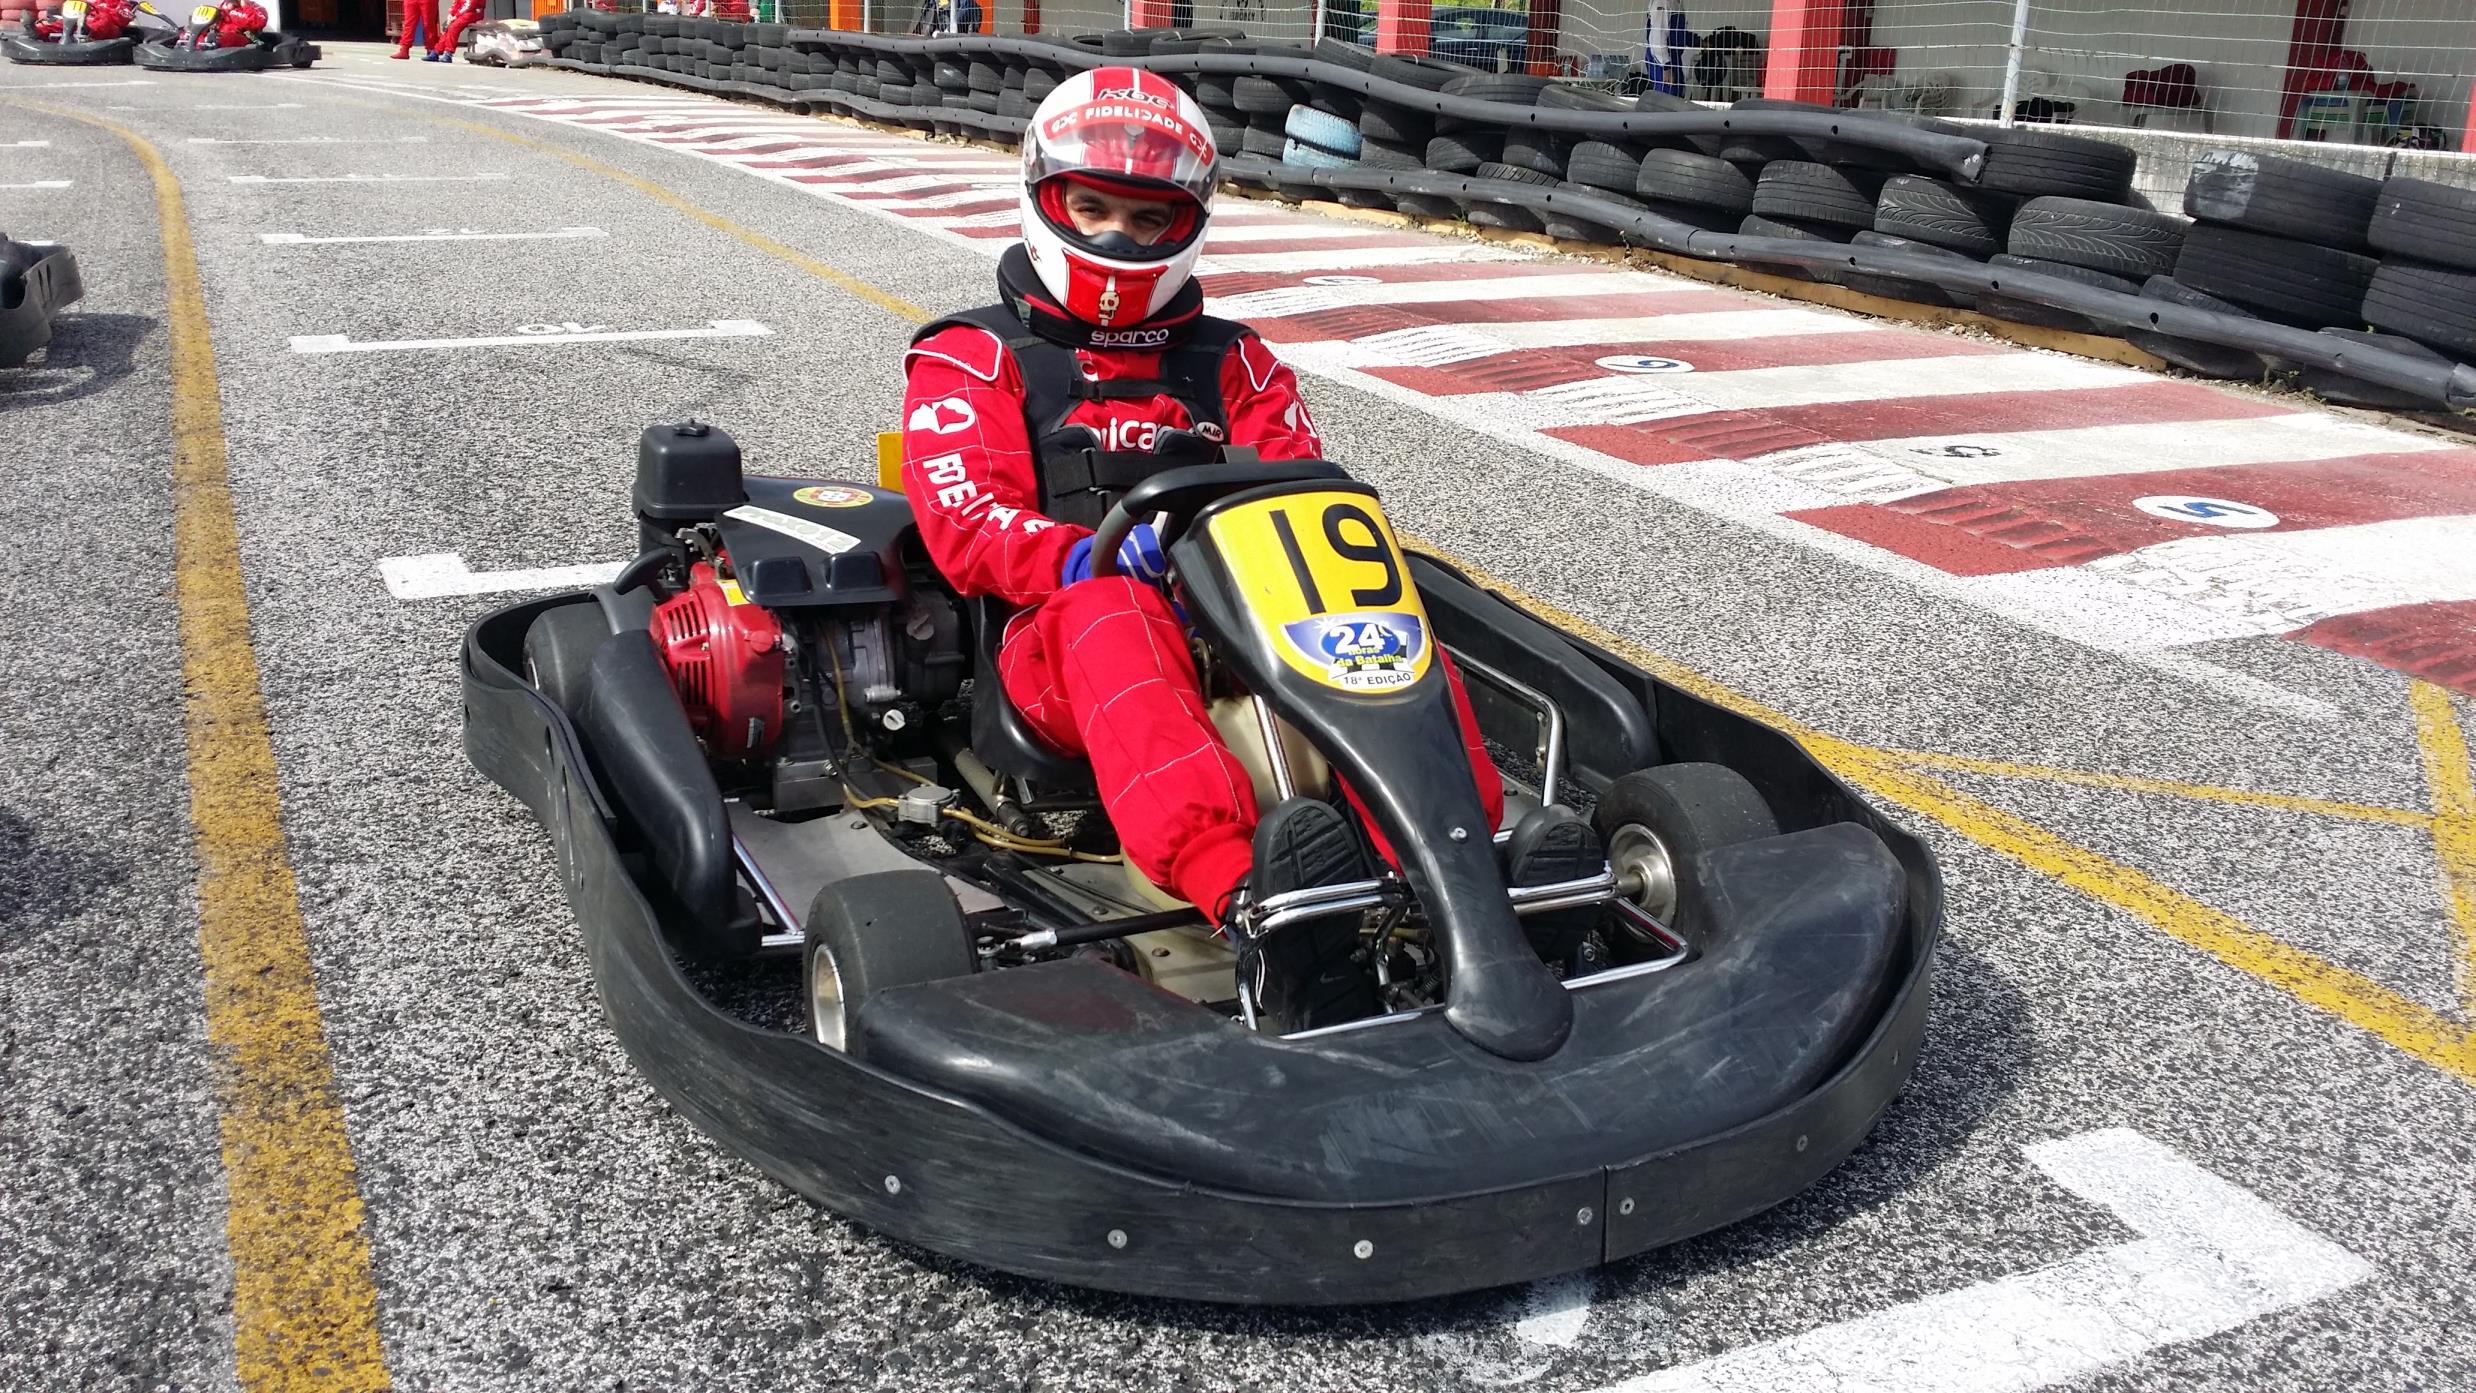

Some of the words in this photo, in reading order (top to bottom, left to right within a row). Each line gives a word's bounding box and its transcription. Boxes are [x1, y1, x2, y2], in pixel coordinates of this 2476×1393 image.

[1085, 105, 1184, 135] FIDELIDADE
[1089, 328, 1170, 348] sparco
[1201, 426, 1222, 440] MIR
[1268, 503, 1402, 616] 19
[1336, 657, 1354, 668] da
[1355, 653, 1404, 666] Batalha
[1366, 672, 1411, 686] EDIÇÃO
